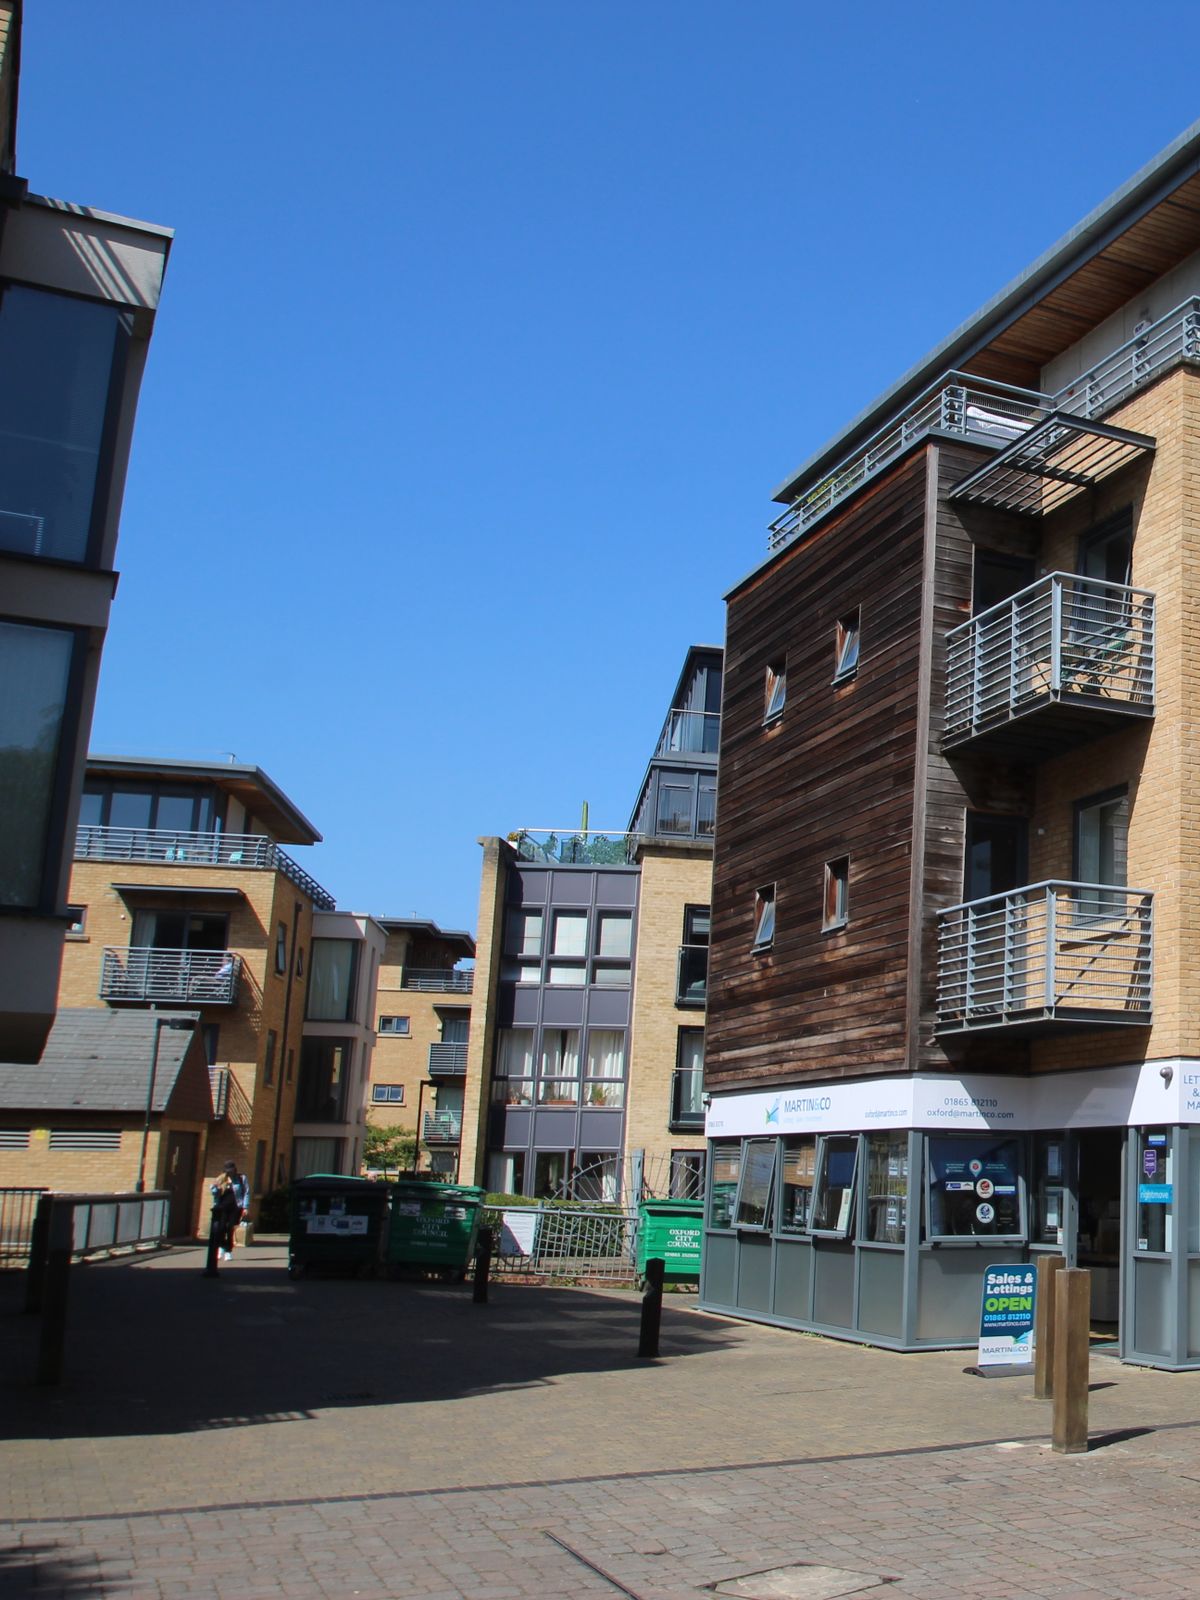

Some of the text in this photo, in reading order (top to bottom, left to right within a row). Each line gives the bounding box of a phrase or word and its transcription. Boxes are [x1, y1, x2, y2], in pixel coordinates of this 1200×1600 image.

[1192, 1089, 1200, 1098] &
[784, 1097, 832, 1113] MARTIN&CO
[944, 1098, 998, 1107] 01865 812110
[927, 1107, 1014, 1119] oxford@martinco.com
[1140, 1189, 1169, 1201] rightmove
[987, 1272, 1034, 1284] Sales &
[986, 1284, 1033, 1295] Lettings
[985, 1297, 1032, 1312] OPEN
[984, 1313, 1031, 1322] 01865 812110
